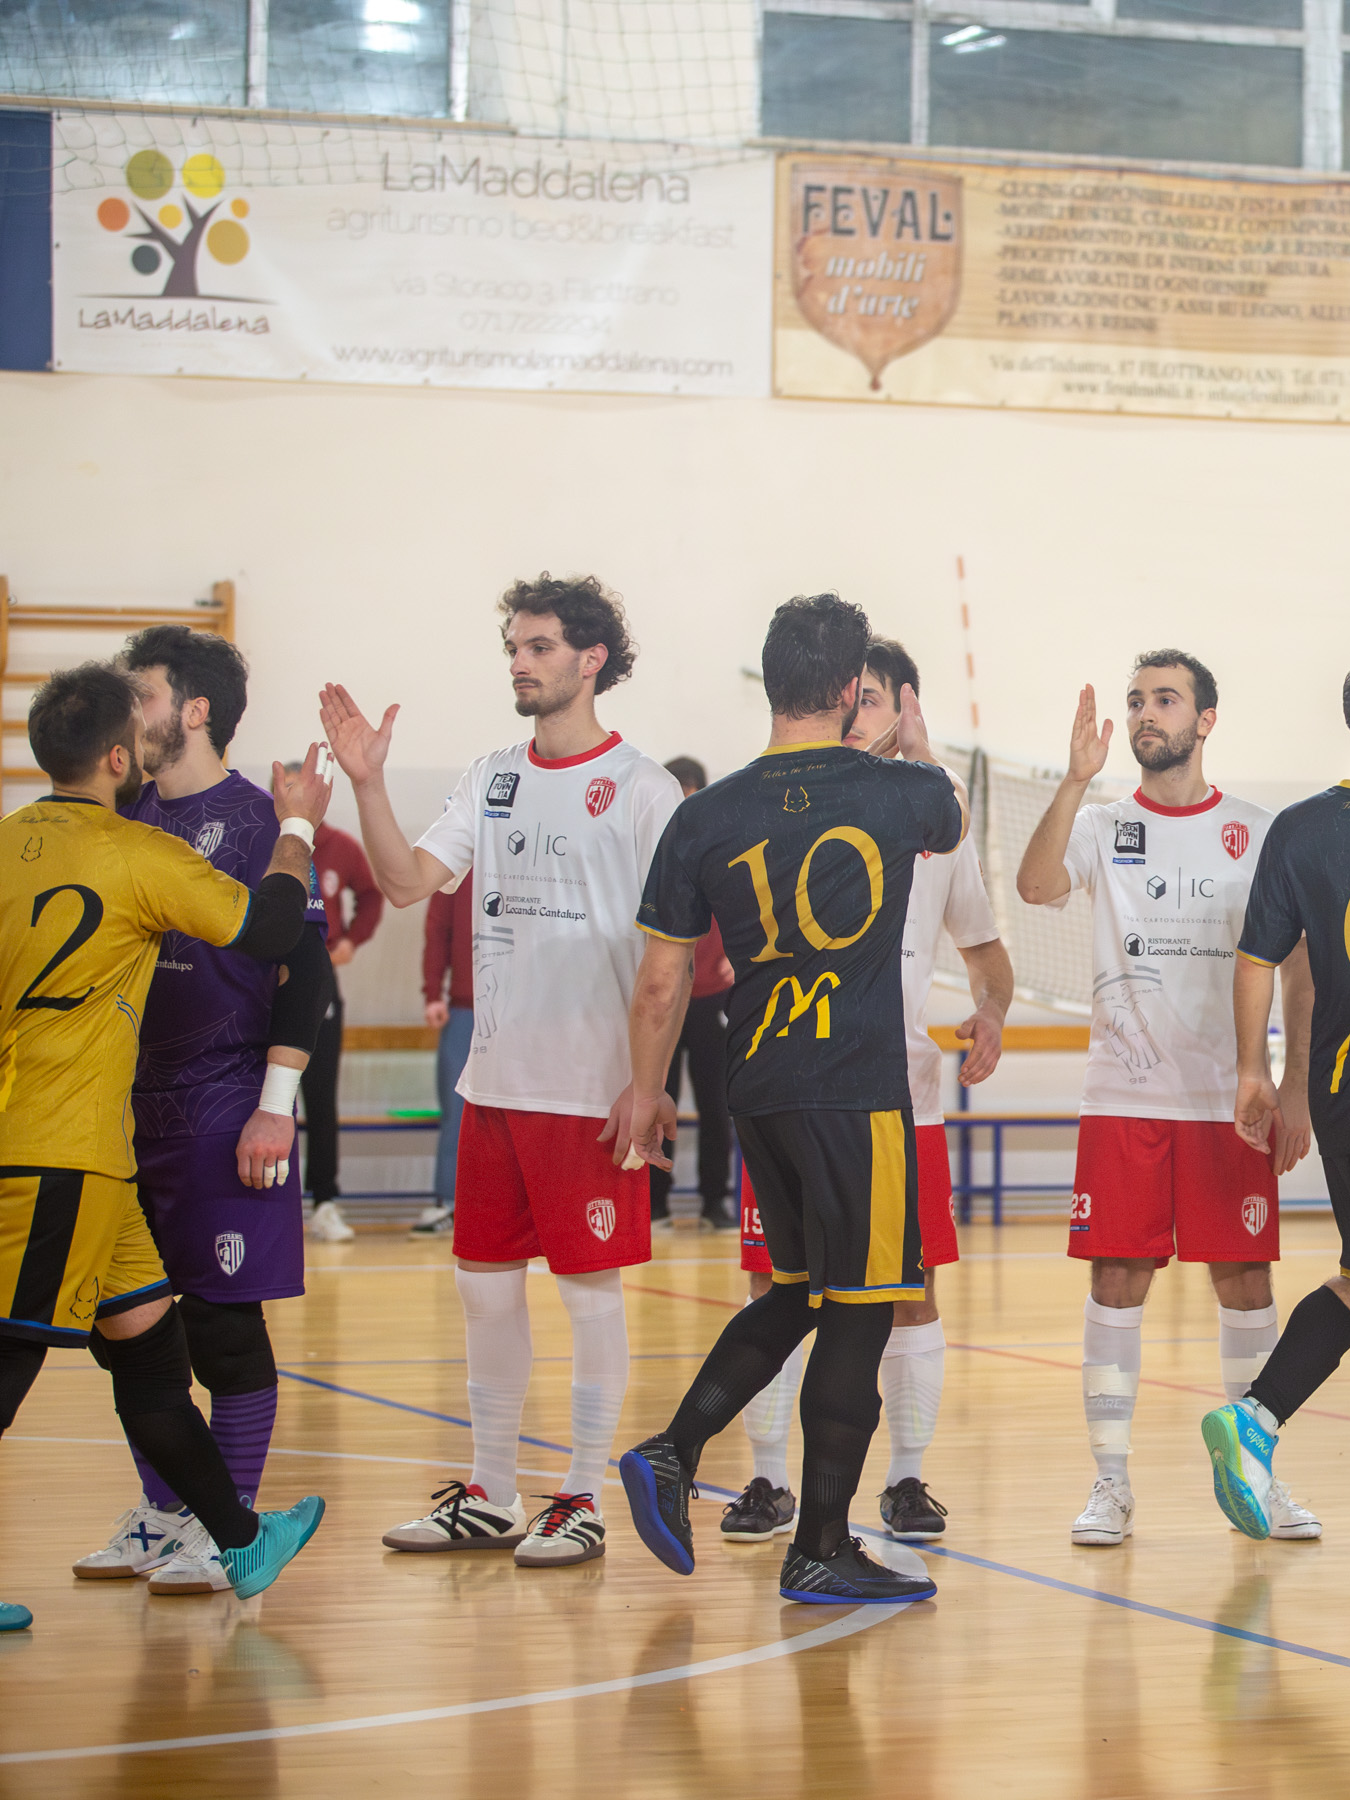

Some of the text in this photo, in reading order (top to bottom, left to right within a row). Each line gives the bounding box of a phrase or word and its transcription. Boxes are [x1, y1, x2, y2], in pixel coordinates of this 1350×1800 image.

[381, 151, 691, 205] LaMaddalena
[325, 204, 504, 240] agriturismo
[802, 184, 953, 242] FEVAL
[826, 250, 927, 283] mobili
[826, 285, 921, 319] d'arte
[77, 305, 271, 335] LaMaddalena
[544, 835, 568, 857] IC
[727, 825, 884, 963] 10
[1190, 878, 1215, 899] IC
[505, 903, 587, 922] Locanda Cantalupo
[15, 884, 104, 1011] 2
[1147, 937, 1192, 946] RISTORANTE
[1147, 945, 1235, 960] Locanda Cantalupo
[155, 960, 194, 973] antalupo
